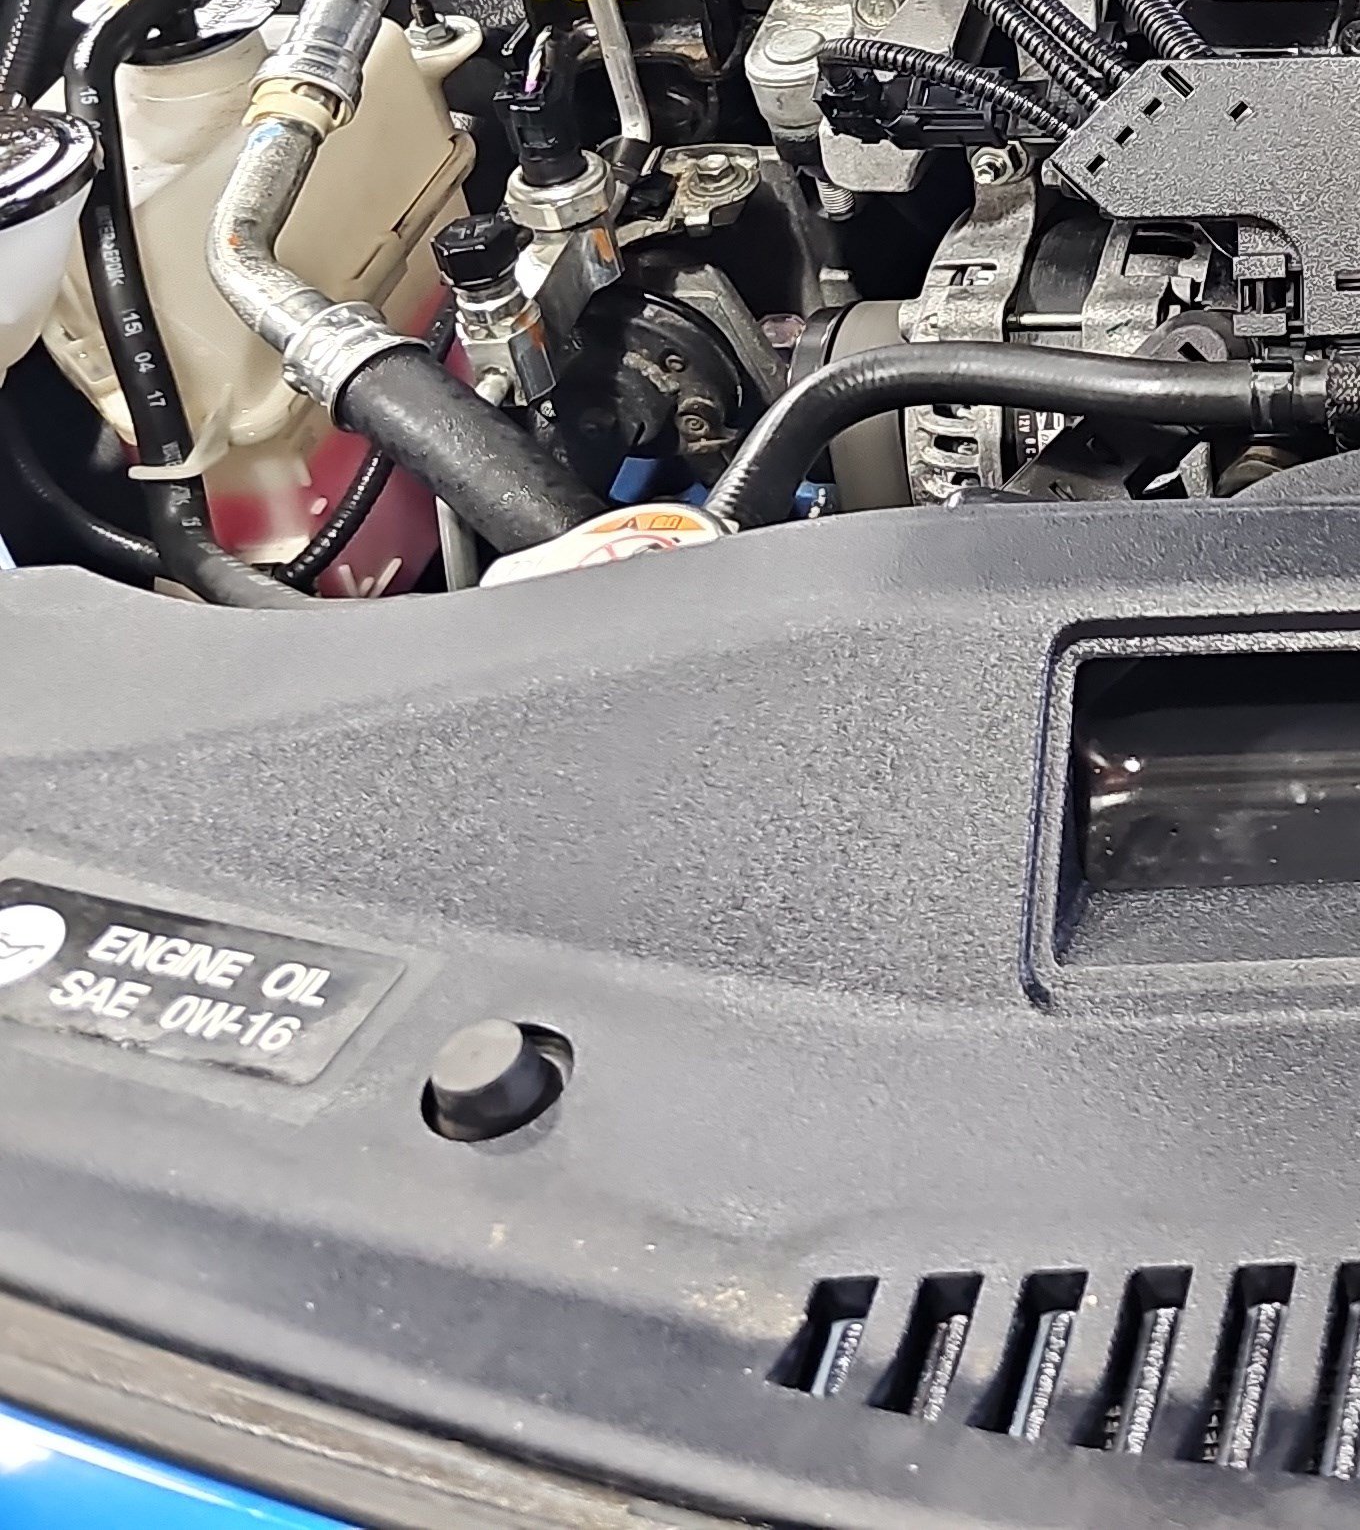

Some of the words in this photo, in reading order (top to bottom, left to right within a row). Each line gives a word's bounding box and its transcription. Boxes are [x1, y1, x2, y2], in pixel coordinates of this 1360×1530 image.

[134, 351, 157, 374] 04
[146, 389, 168, 409] 17
[88, 923, 254, 991] ENGINE
[261, 962, 332, 1009] OIL
[50, 970, 152, 1020] SAE
[159, 994, 304, 1054] 0W-16
